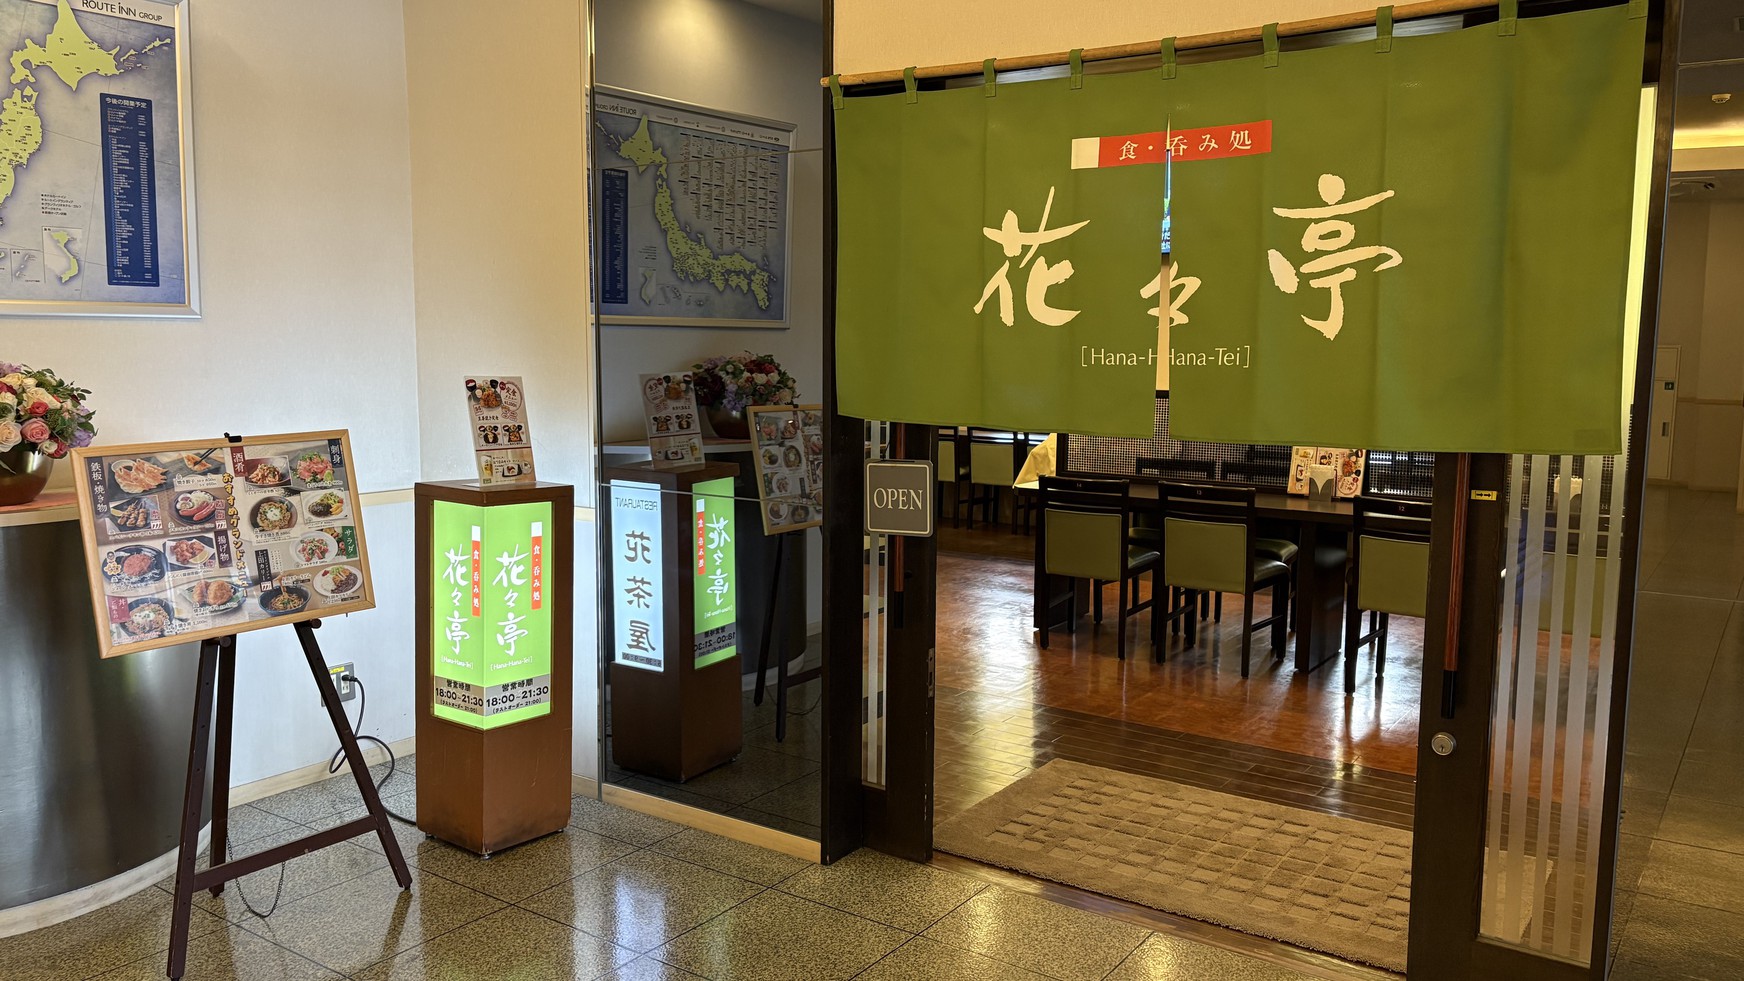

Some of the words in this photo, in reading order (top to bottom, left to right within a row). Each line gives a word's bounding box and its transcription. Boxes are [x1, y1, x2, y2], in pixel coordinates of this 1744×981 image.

[82, 0, 116, 13] ROUTE
[138, 11, 163, 21] GROUP
[873, 487, 923, 510] OPEN
[344, 528, 355, 554] サラダ
[533, 544, 541, 601] 食・呑み処
[442, 543, 471, 655] 花々亭
[492, 543, 530, 657] 花々亭
[446, 679, 471, 692] 営業時間
[501, 678, 533, 692] 営業時間
